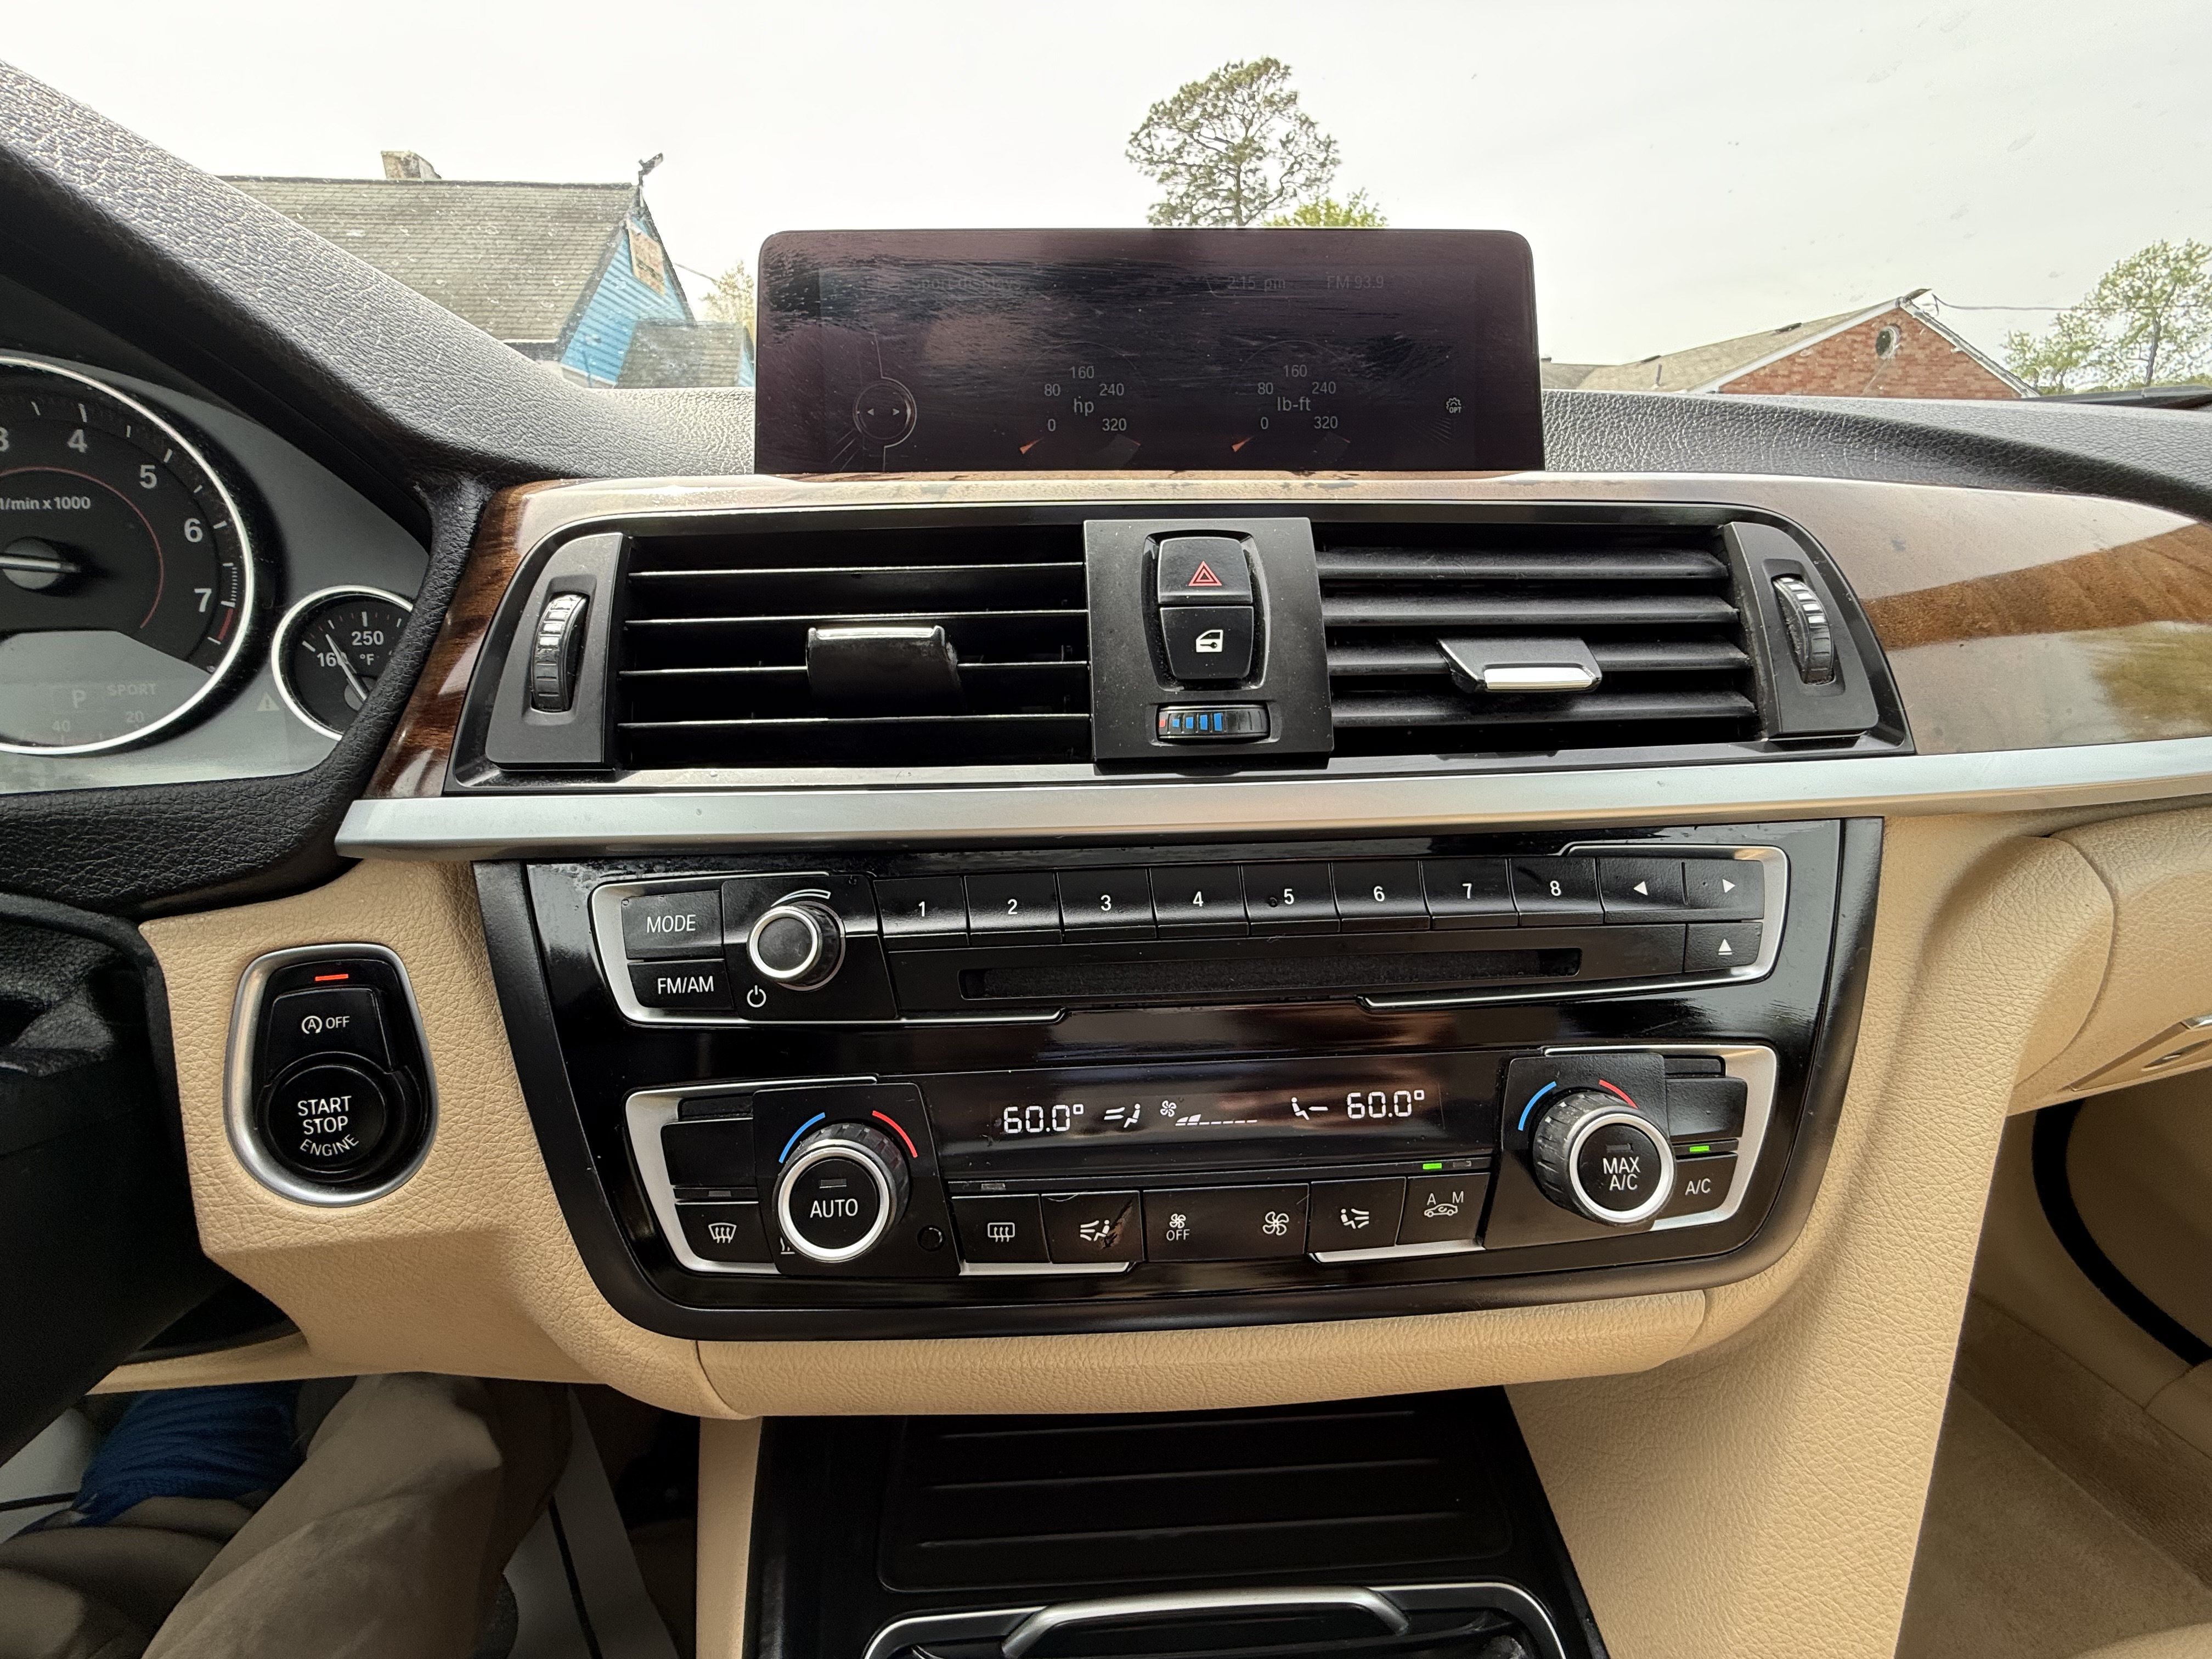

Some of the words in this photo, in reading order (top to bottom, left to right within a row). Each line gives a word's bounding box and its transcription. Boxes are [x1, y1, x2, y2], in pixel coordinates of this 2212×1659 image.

[1264, 278, 1286, 291] pm
[1327, 275, 1350, 289] FM
[1354, 275, 1384, 289] 93.9
[1070, 366, 1094, 379] 160
[1283, 365, 1308, 378] 160
[1045, 383, 1061, 397] 80
[1099, 383, 1125, 397] 240
[1257, 382, 1273, 395] 80
[1312, 382, 1336, 394] 240
[1074, 398, 1094, 415] hp
[1277, 397, 1311, 411] lb-ft
[1048, 419, 1056, 432] 0
[1102, 419, 1127, 431] 320
[1261, 417, 1268, 430] 0
[1314, 416, 1338, 430] 320
[67, 429, 88, 453] 4
[139, 465, 157, 489] 5
[42, 500, 52, 510] x
[54, 496, 91, 510] 1000
[184, 518, 203, 543] 6
[194, 589, 212, 612] 7
[351, 630, 384, 646] 250
[107, 684, 156, 696] SPORT
[71, 689, 87, 709] P
[1283, 889, 1294, 905] 5
[1373, 885, 1385, 901] 6
[1462, 883, 1472, 899] 7
[1550, 881, 1562, 897] 8
[1007, 899, 1018, 915] 2
[1101, 895, 1111, 911] 3
[1193, 891, 1204, 907] 4
[918, 902, 926, 917] 1
[646, 915, 696, 933] MODE
[658, 975, 714, 994] FM/AM
[326, 1016, 350, 1029] OFF
[298, 1096, 352, 1116] START
[302, 1116, 348, 1135] STOP
[300, 1134, 359, 1156] ENGINE
[1603, 1157, 1640, 1174] MAX
[1609, 1174, 1638, 1191] A/C
[1685, 1178, 1711, 1195] A/C
[1426, 1193, 1436, 1205] A
[1452, 1191, 1464, 1203] M
[810, 1198, 859, 1218] AUTO
[1166, 1229, 1190, 1241] OFF
